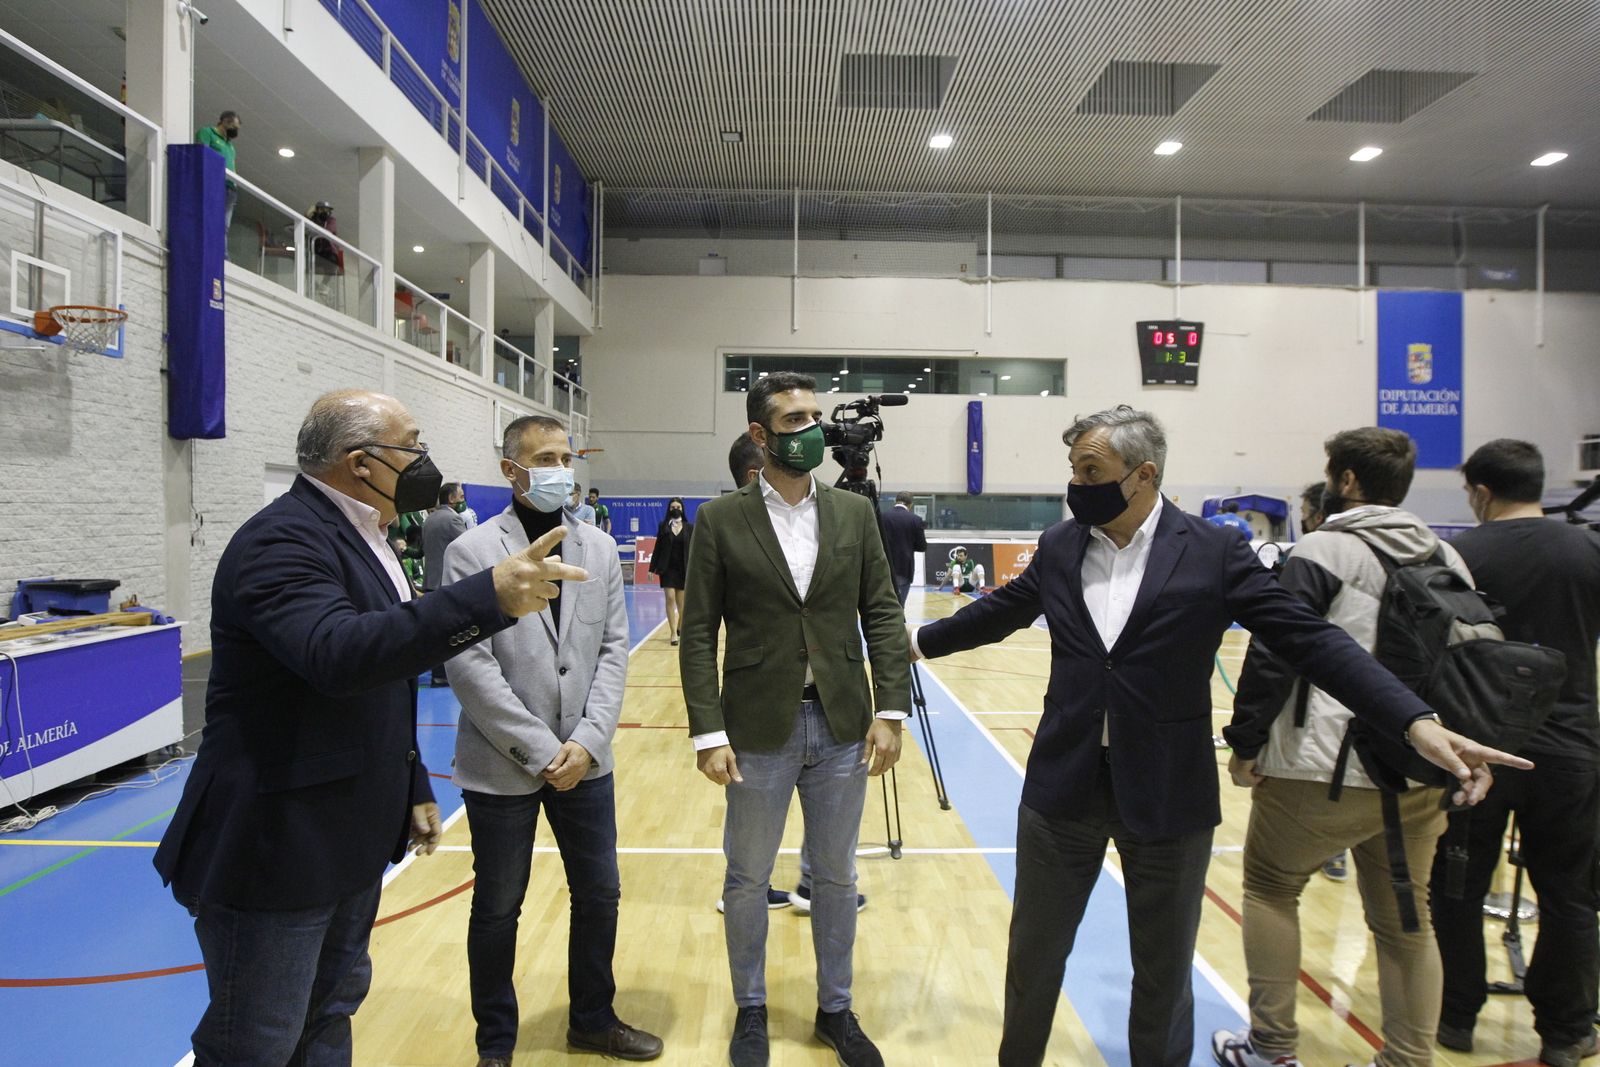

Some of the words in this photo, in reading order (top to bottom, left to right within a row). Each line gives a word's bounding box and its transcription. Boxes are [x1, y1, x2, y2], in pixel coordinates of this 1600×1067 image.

[1380, 388, 1460, 402] DIPUTACIÓN
[1381, 402, 1399, 415] DE
[1401, 402, 1458, 416] ALMERÍA
[16, 719, 78, 753] ALMERÍA
